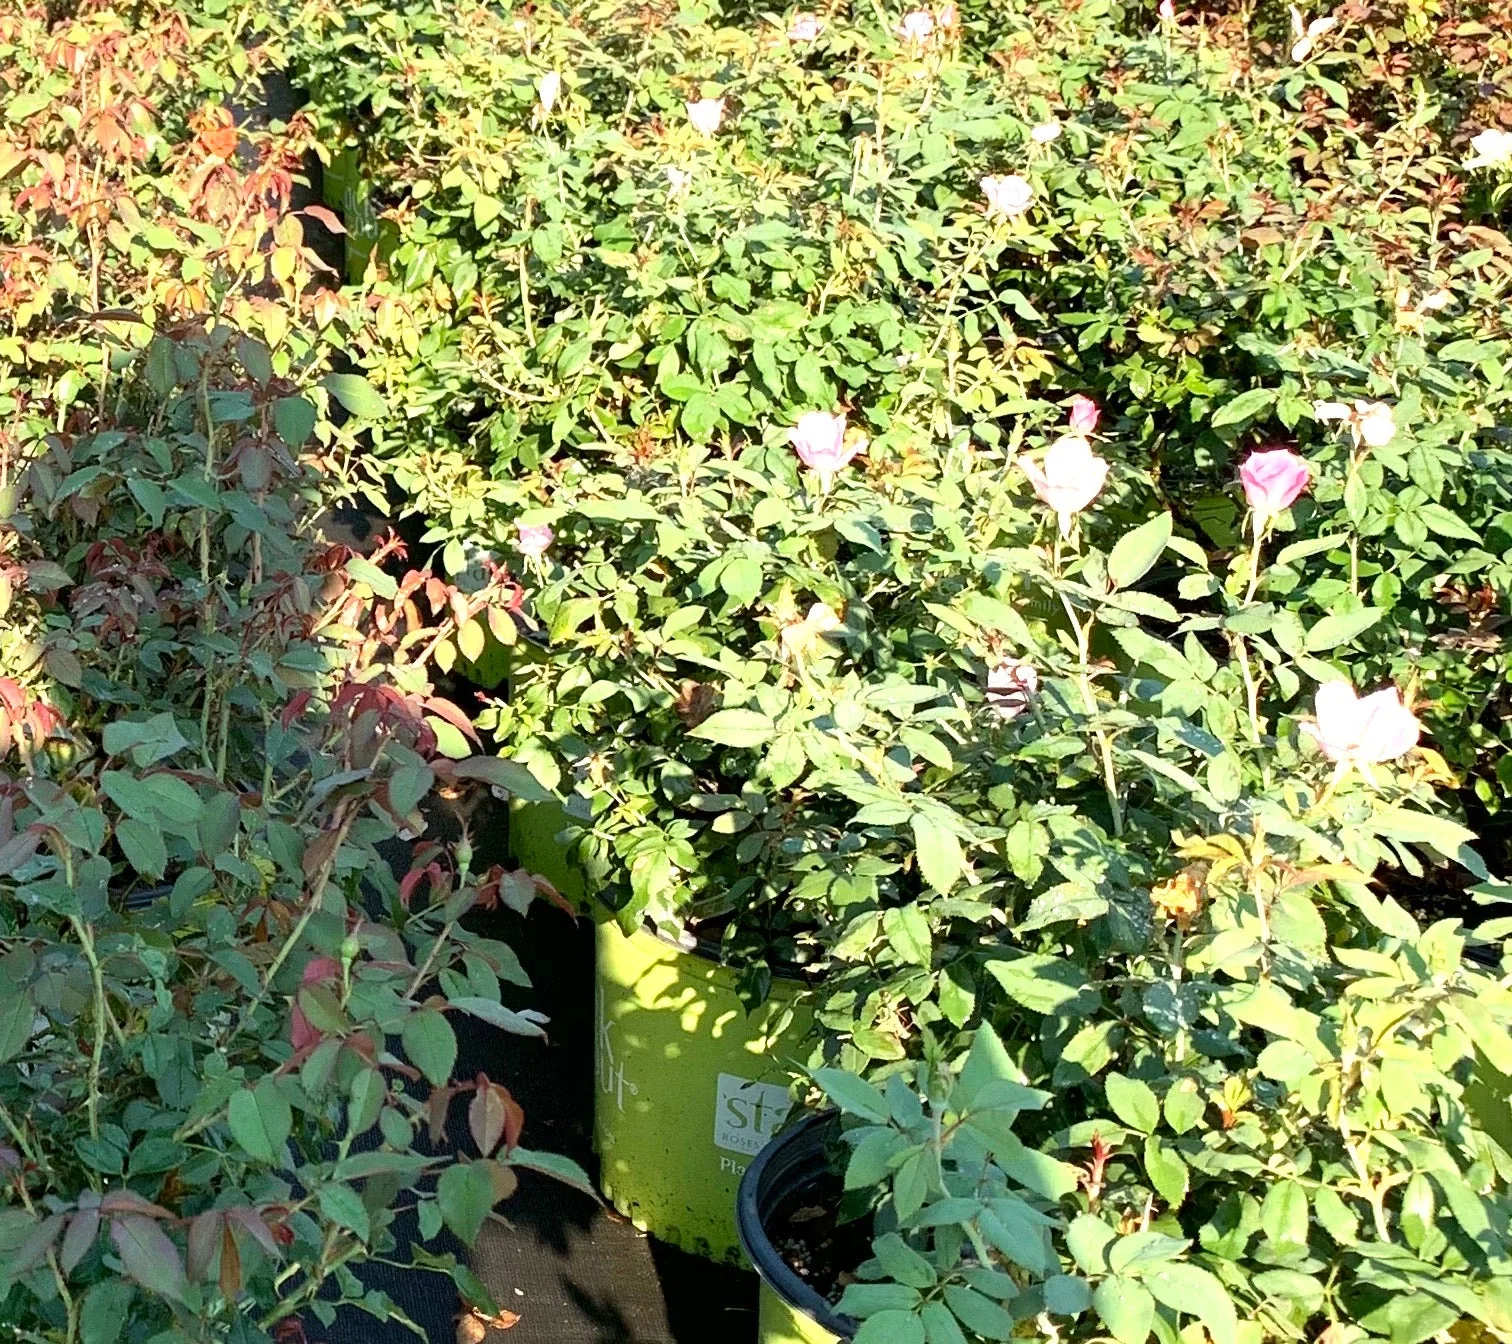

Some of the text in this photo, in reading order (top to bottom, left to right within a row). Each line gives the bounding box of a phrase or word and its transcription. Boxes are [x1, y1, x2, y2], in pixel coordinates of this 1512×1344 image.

[726, 1090, 788, 1134] st
[721, 1132, 761, 1149] ROSES
[720, 1156, 746, 1177] Pla
